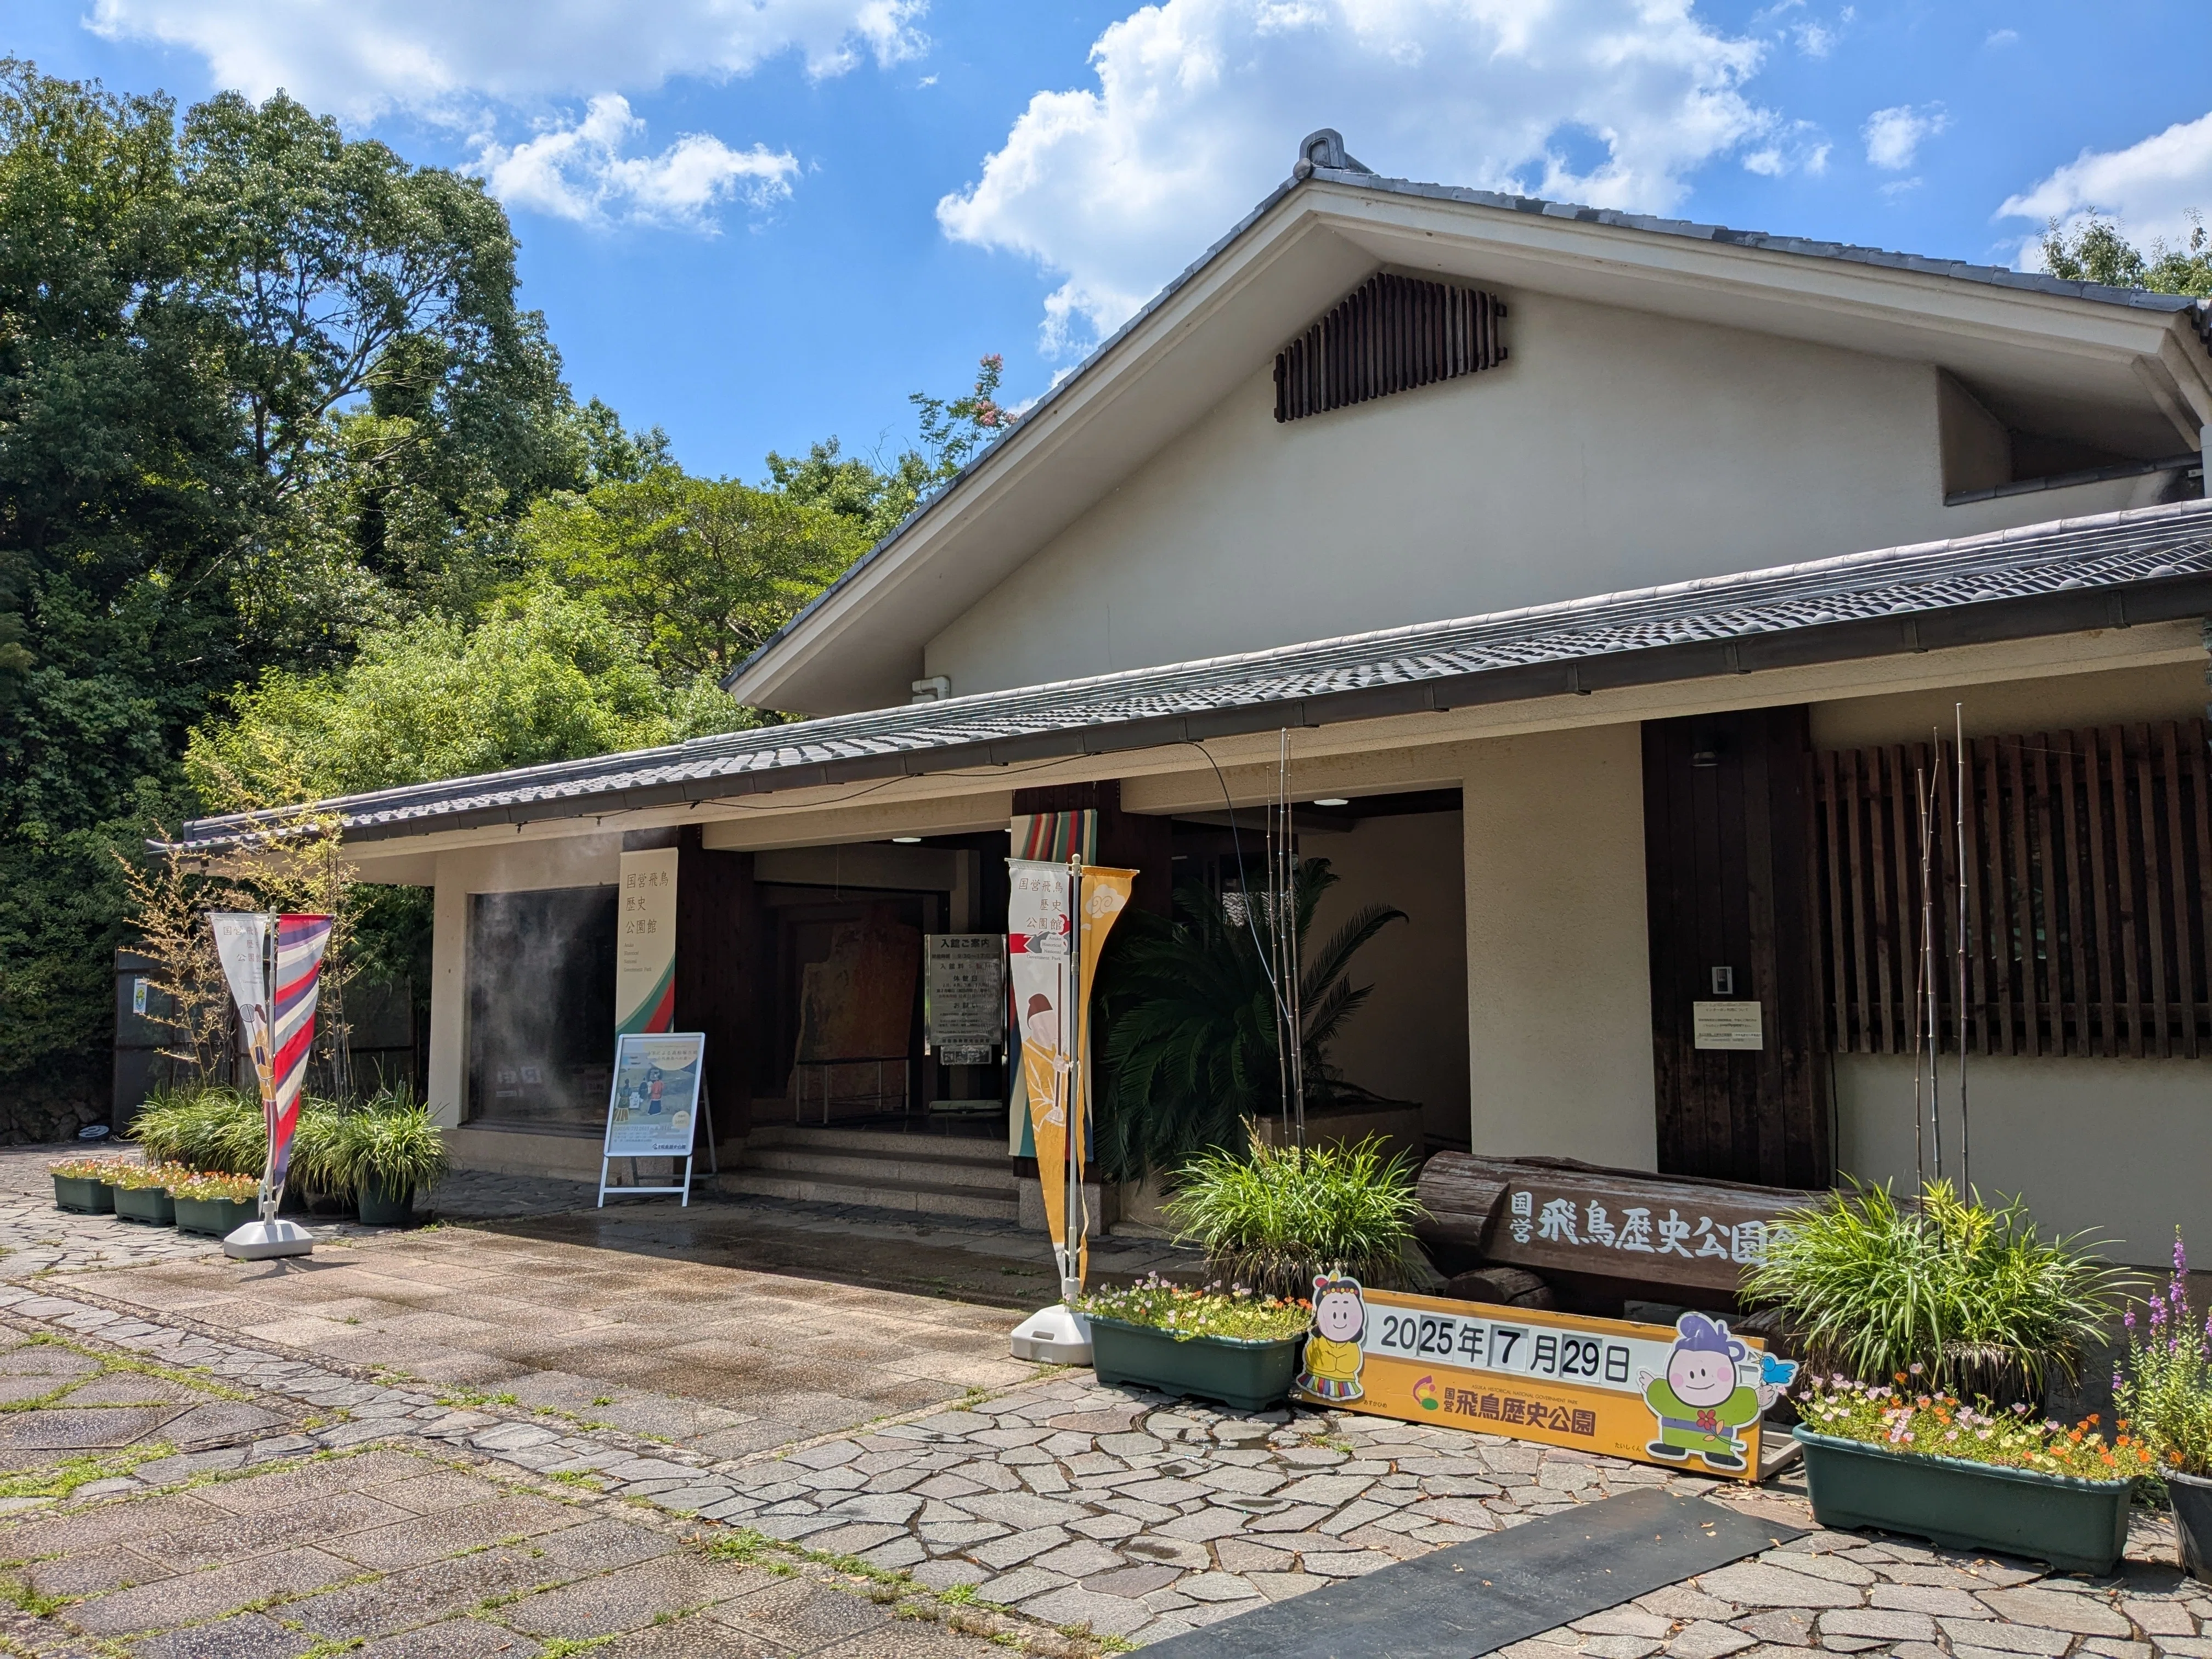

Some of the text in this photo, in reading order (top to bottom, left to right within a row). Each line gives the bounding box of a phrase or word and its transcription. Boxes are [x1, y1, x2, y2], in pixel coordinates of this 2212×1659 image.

[627, 871, 669, 889] 国営飛鳥
[1019, 878, 1063, 894] 国営飛鳥
[625, 896, 646, 911] 歴史
[1040, 899, 1062, 912] 歴史
[625, 918, 657, 934] 公園館
[1026, 917, 1062, 930] 公園館
[940, 939, 990, 948] 入館ご案内
[1509, 1191, 1532, 1244] 国営
[1537, 1198, 1809, 1267] 飛鳥歴史公園
[1380, 1315, 1630, 1383] 2025年7月29日
[1363, 1400, 1387, 1408] あすかひめ
[1443, 1387, 1455, 1413] 国営
[1536, 1394, 1566, 1403] GOVERNMENT
[1454, 1389, 1596, 1437] 飛鳥歴史公園
[1615, 1442, 1641, 1452] たいしくん
